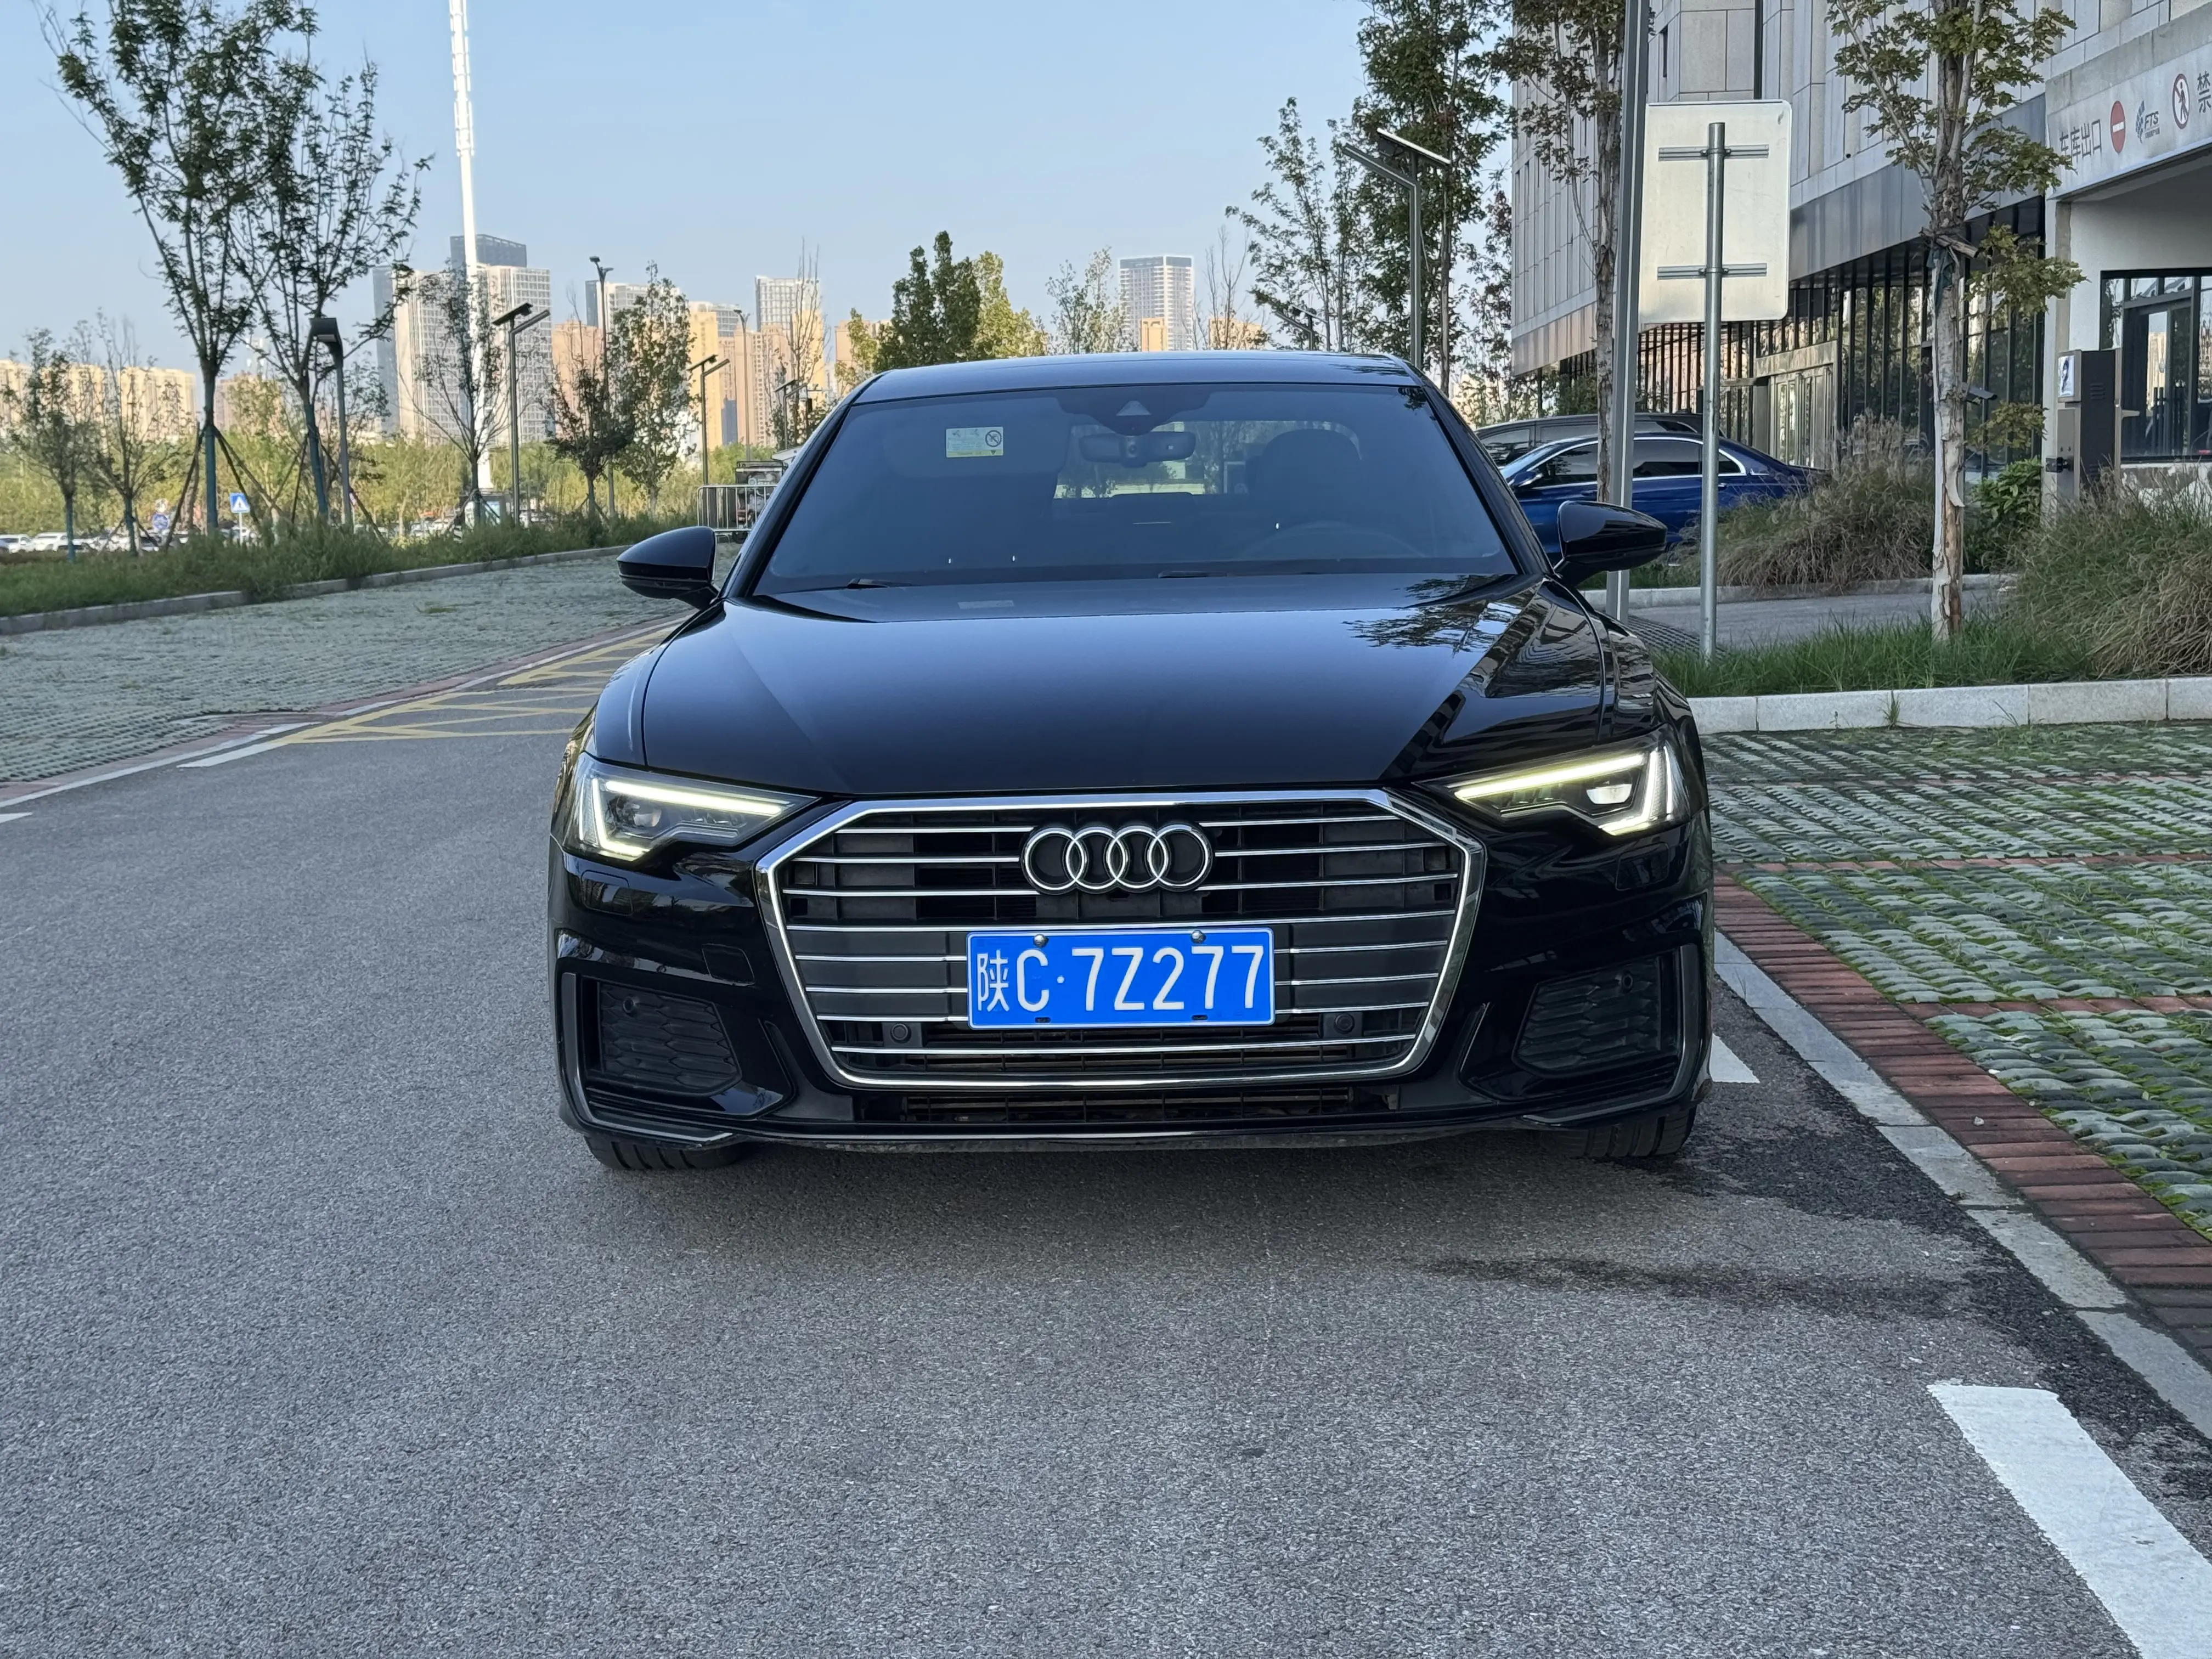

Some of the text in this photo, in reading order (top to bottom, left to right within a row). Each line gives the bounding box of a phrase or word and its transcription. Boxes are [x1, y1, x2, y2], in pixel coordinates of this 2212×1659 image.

[2197, 70, 2211, 113] 禁
[2059, 119, 2102, 163] 车库出口
[2145, 111, 2159, 130] FTS
